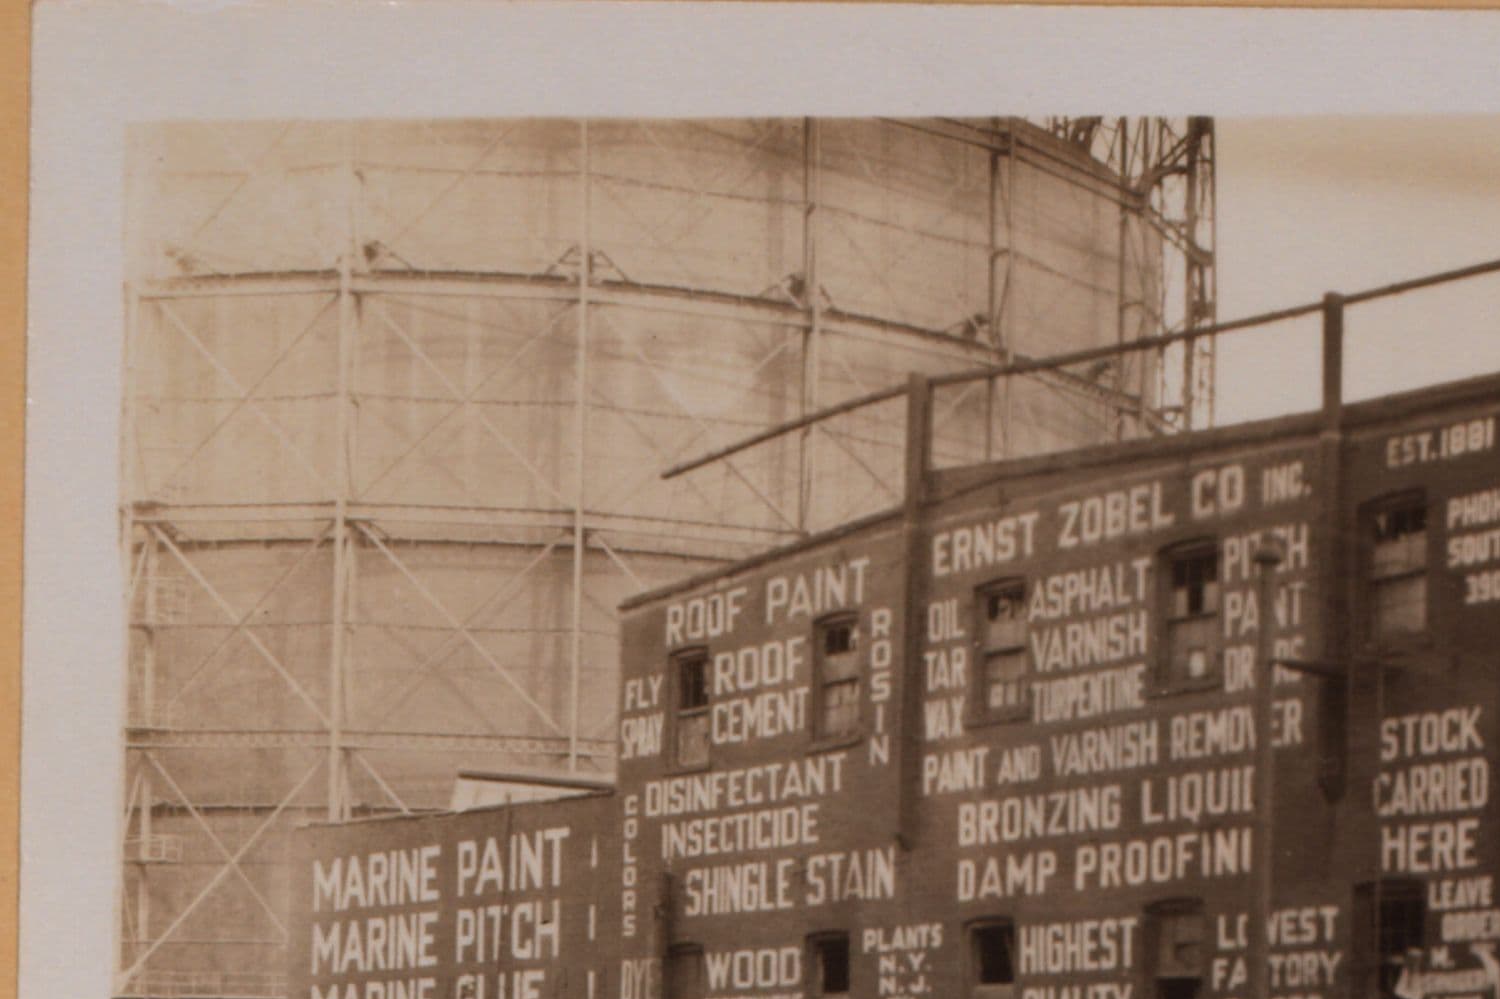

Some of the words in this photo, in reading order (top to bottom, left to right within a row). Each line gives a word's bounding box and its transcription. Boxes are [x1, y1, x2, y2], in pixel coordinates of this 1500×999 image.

[932, 511, 1040, 577] ERNST
[1058, 481, 1175, 549] ZOBEL
[1191, 464, 1245, 520] CO
[1262, 461, 1312, 499] INC.
[665, 587, 748, 647] ROOF
[765, 559, 870, 625] PAINT
[1027, 556, 1152, 624] ASPHALT
[1223, 581, 1307, 640] PANT
[927, 598, 966, 644] OIL
[1031, 610, 1148, 674] VARNISH
[624, 674, 664, 711] FLY
[713, 636, 806, 696] ROOF
[869, 608, 892, 766] ROSIN
[924, 646, 967, 693] TAR
[1031, 663, 1146, 725] TURPENTINE
[712, 686, 810, 745] CEMENT
[924, 697, 966, 741] WAX
[1380, 704, 1484, 762] STOCK
[645, 752, 848, 817] DISINFECTANT
[923, 748, 990, 797] PAINT
[1000, 745, 1041, 784] AND
[1051, 720, 1159, 778] VARNISH
[1374, 757, 1490, 817] CARRIED
[661, 804, 820, 860] INSECTICIDE
[957, 784, 1122, 847] BRONZING
[312, 844, 441, 912] MARINE
[457, 827, 570, 897] PAINT
[622, 795, 638, 937] COLORS
[1381, 818, 1480, 874] HERE
[685, 858, 795, 917] SHINGLE
[806, 847, 896, 906] STAIN
[957, 850, 1058, 902] DAMP
[1427, 876, 1494, 911] LEAVE
[311, 911, 439, 975] MARINE
[455, 898, 561, 963] PITCH
[863, 922, 944, 953] PLANTS
[1018, 916, 1138, 975] HIGHEST
[705, 947, 802, 990] WOOD
[1212, 950, 1342, 991] FATORY
